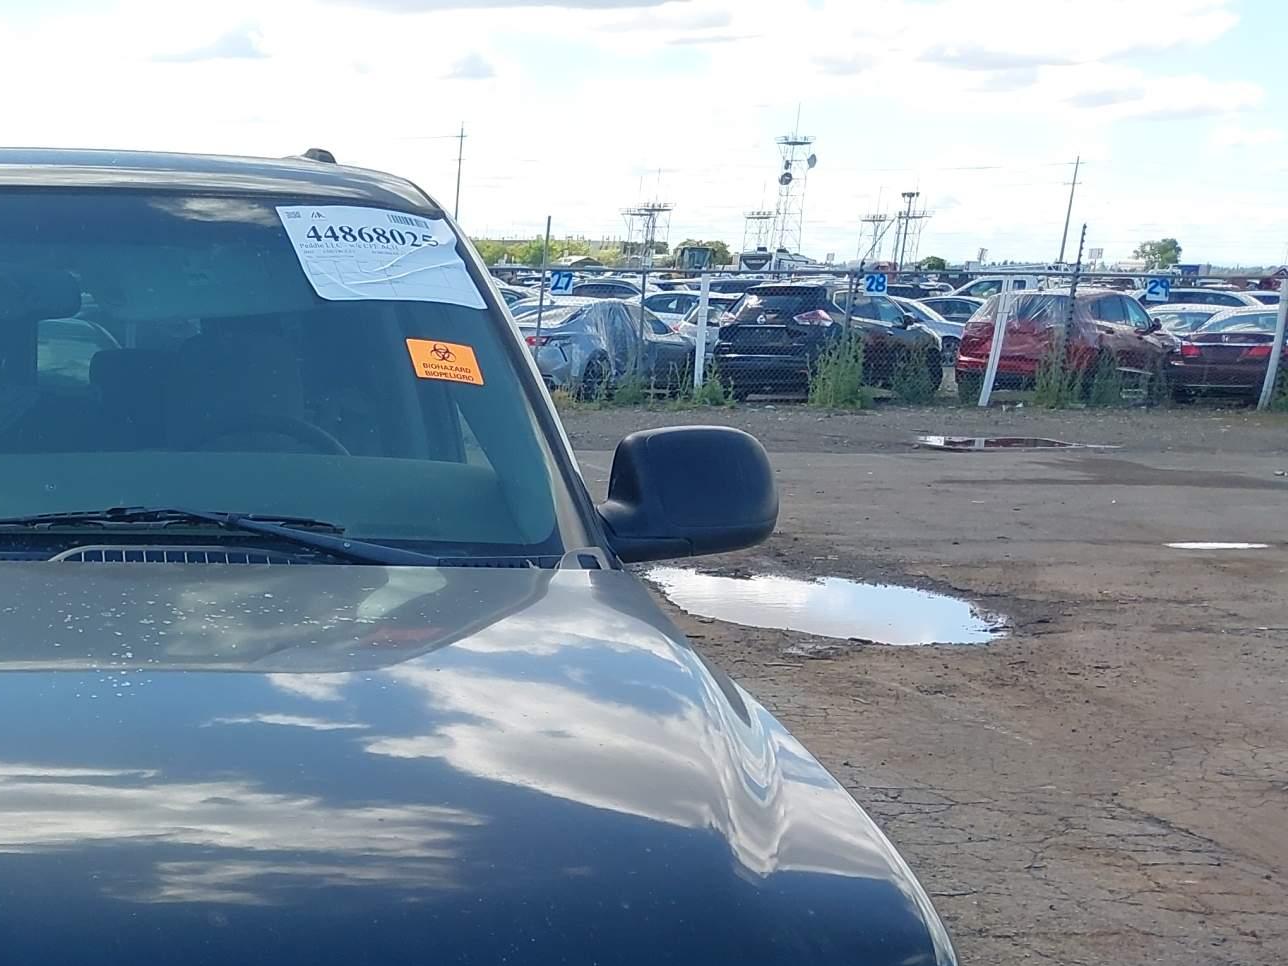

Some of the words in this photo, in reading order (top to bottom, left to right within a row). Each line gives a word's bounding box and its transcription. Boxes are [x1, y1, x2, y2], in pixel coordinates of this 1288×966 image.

[306, 225, 439, 247] 44868025
[551, 271, 572, 291] 27
[866, 273, 886, 292] 28
[1148, 278, 1169, 298] 29
[423, 362, 471, 374] BIOHAZARD
[425, 370, 474, 382] BIOPELIGRO
